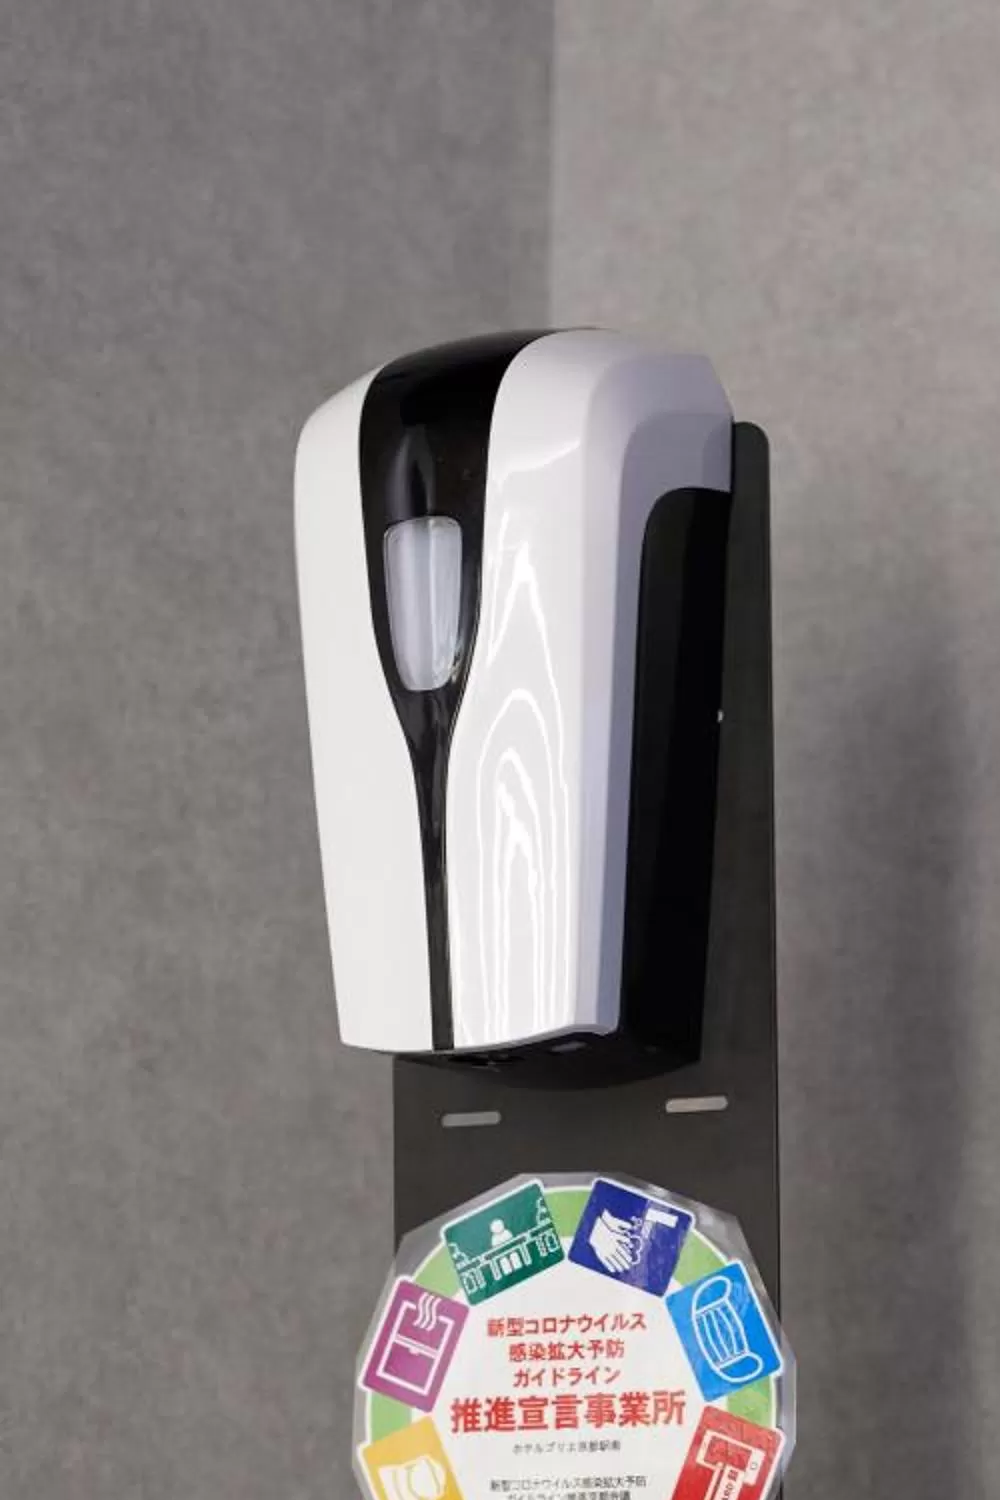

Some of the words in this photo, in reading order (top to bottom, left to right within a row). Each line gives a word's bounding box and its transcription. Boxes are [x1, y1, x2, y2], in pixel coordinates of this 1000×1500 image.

[486, 1312, 647, 1338] 新型コロナウイルス
[508, 1338, 625, 1363] 感染拡大予防
[512, 1366, 621, 1388] ガイドライン
[450, 1389, 687, 1434] 推進宣言事業所
